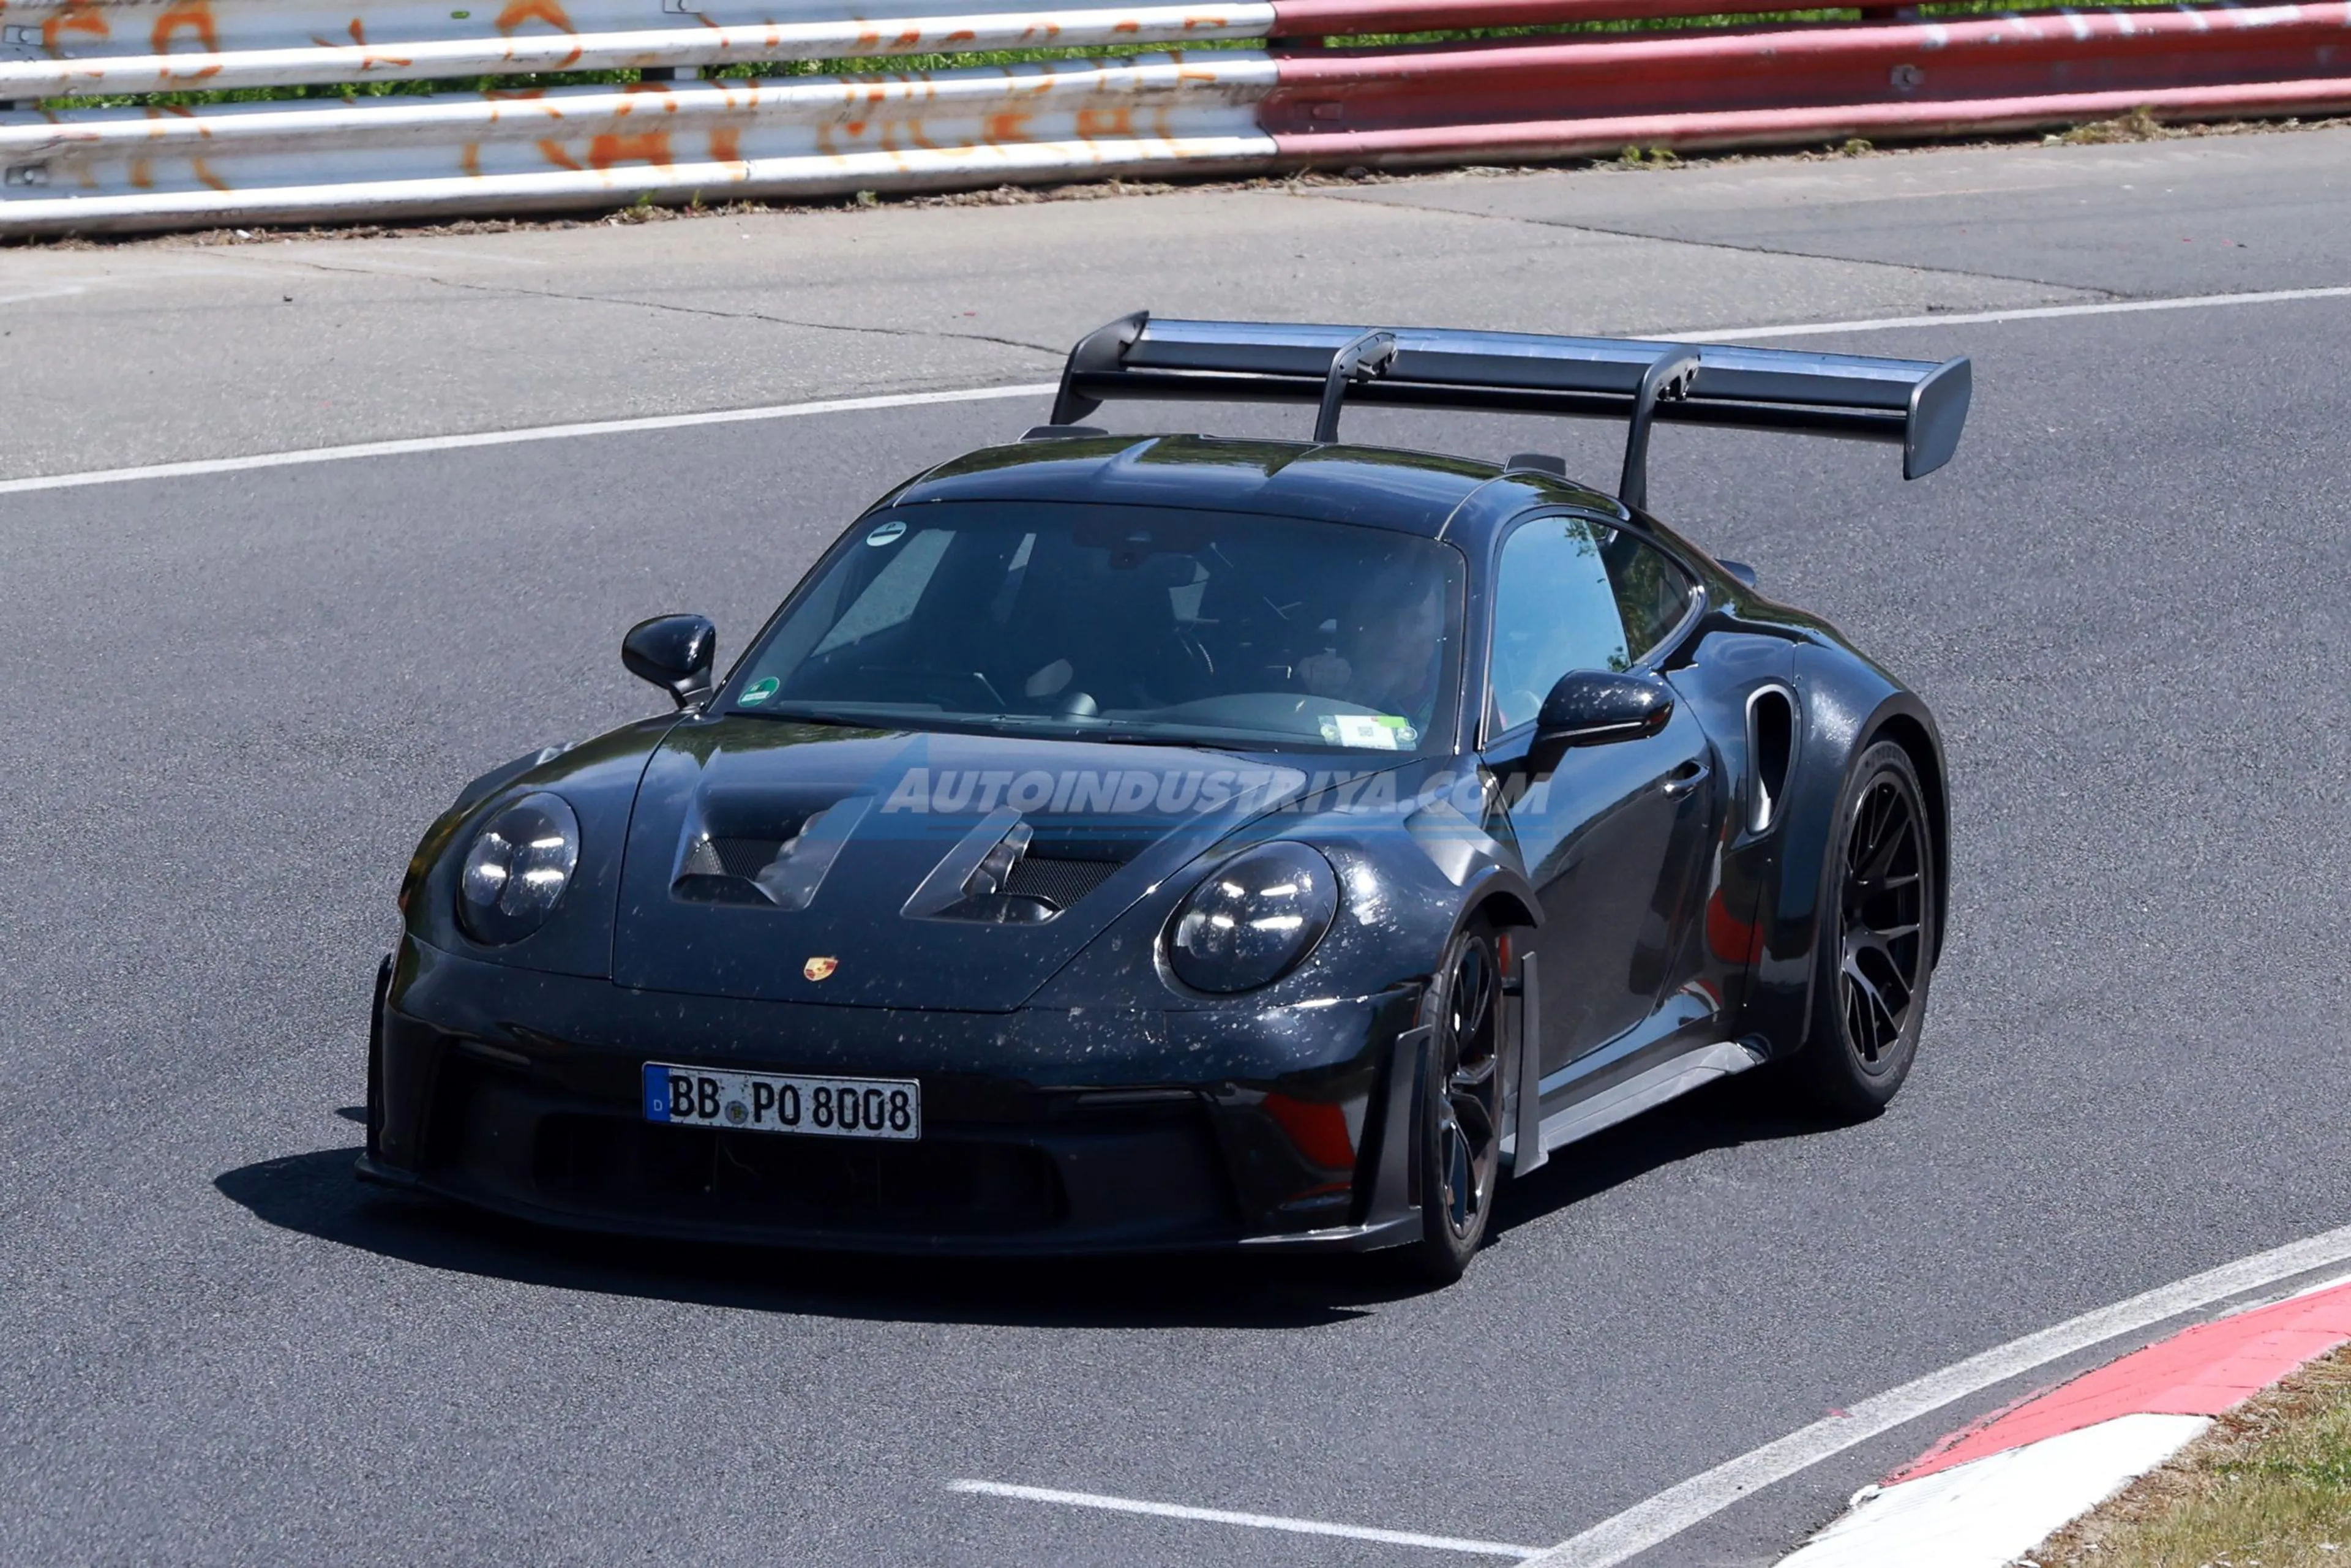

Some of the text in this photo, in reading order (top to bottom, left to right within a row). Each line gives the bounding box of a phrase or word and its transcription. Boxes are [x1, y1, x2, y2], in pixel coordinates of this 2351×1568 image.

[653, 1099, 662, 1111] D
[669, 1075, 911, 1131] BB PO 8008
